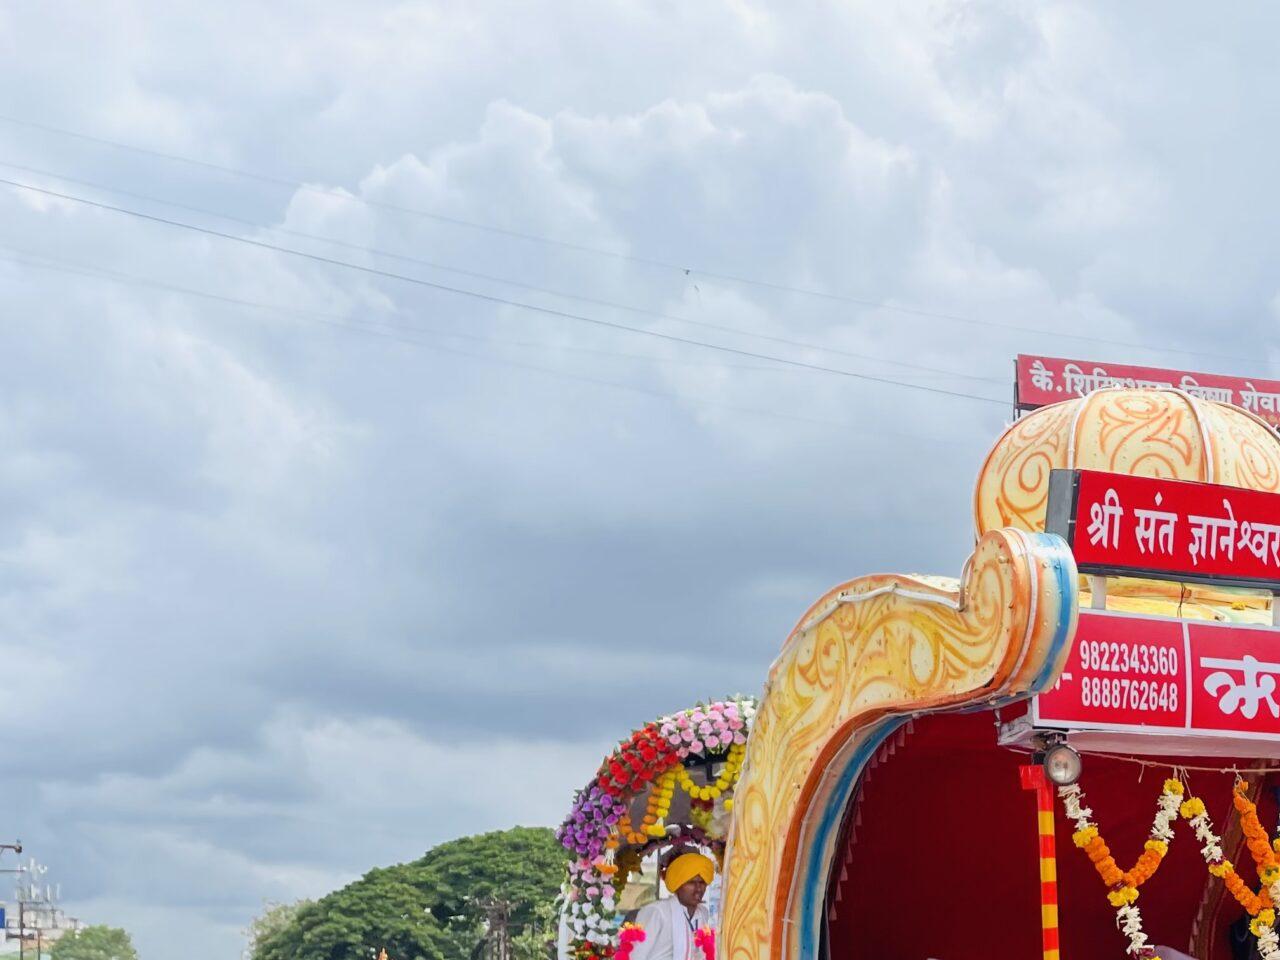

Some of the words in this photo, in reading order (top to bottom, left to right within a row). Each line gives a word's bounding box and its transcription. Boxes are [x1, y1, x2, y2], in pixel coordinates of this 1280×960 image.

[1087, 488, 1124, 550] श्री
[1134, 491, 1178, 556] संत
[1080, 640, 1178, 676] 9822343360
[1081, 676, 1178, 712] 8888762648
